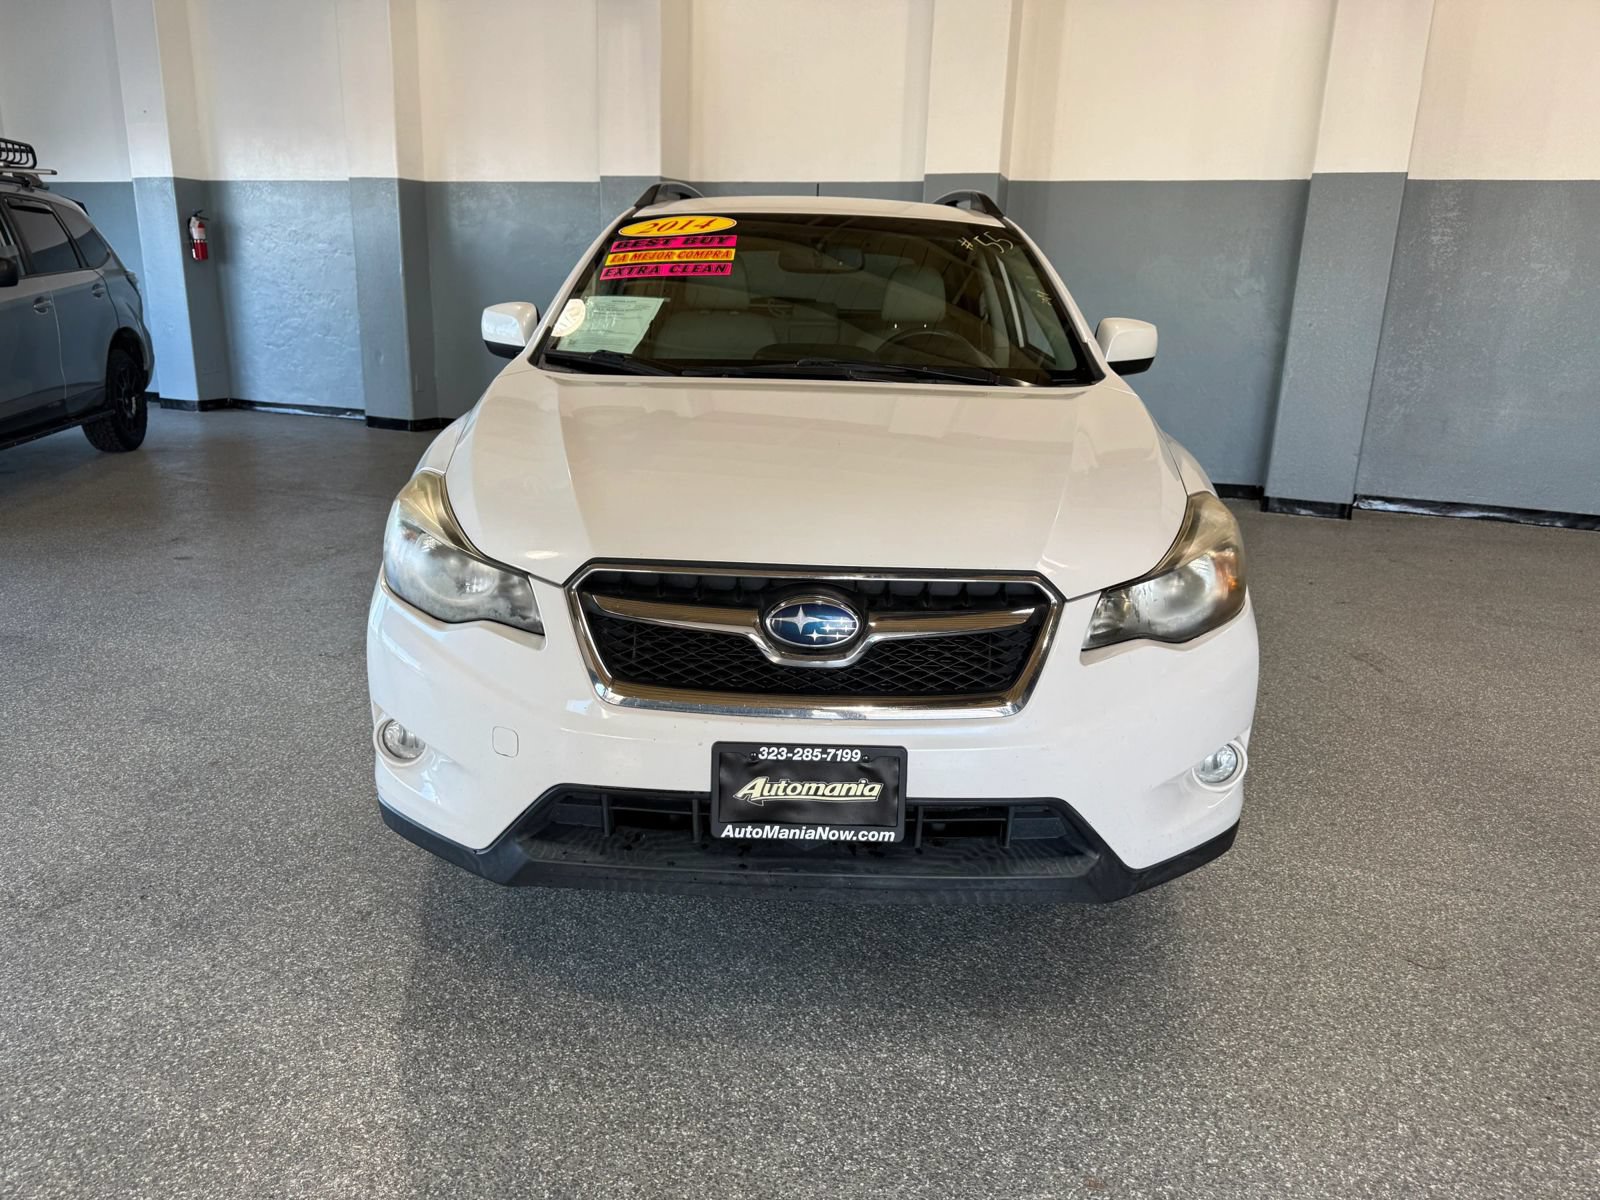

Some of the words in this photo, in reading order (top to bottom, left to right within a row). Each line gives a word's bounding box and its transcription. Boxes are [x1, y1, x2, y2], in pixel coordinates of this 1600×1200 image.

[637, 217, 718, 234] 2014
[613, 238, 673, 249] BEST
[682, 236, 730, 246] BUY
[610, 254, 629, 263] LA
[630, 252, 674, 261] MEJOR
[677, 250, 730, 260] COMPRA
[603, 265, 660, 277] EXTRA
[668, 263, 727, 274] CLEAN
[758, 747, 861, 762] 323-285-7199
[734, 776, 883, 799] Automania
[721, 824, 895, 842] AutoManiaNow.com
